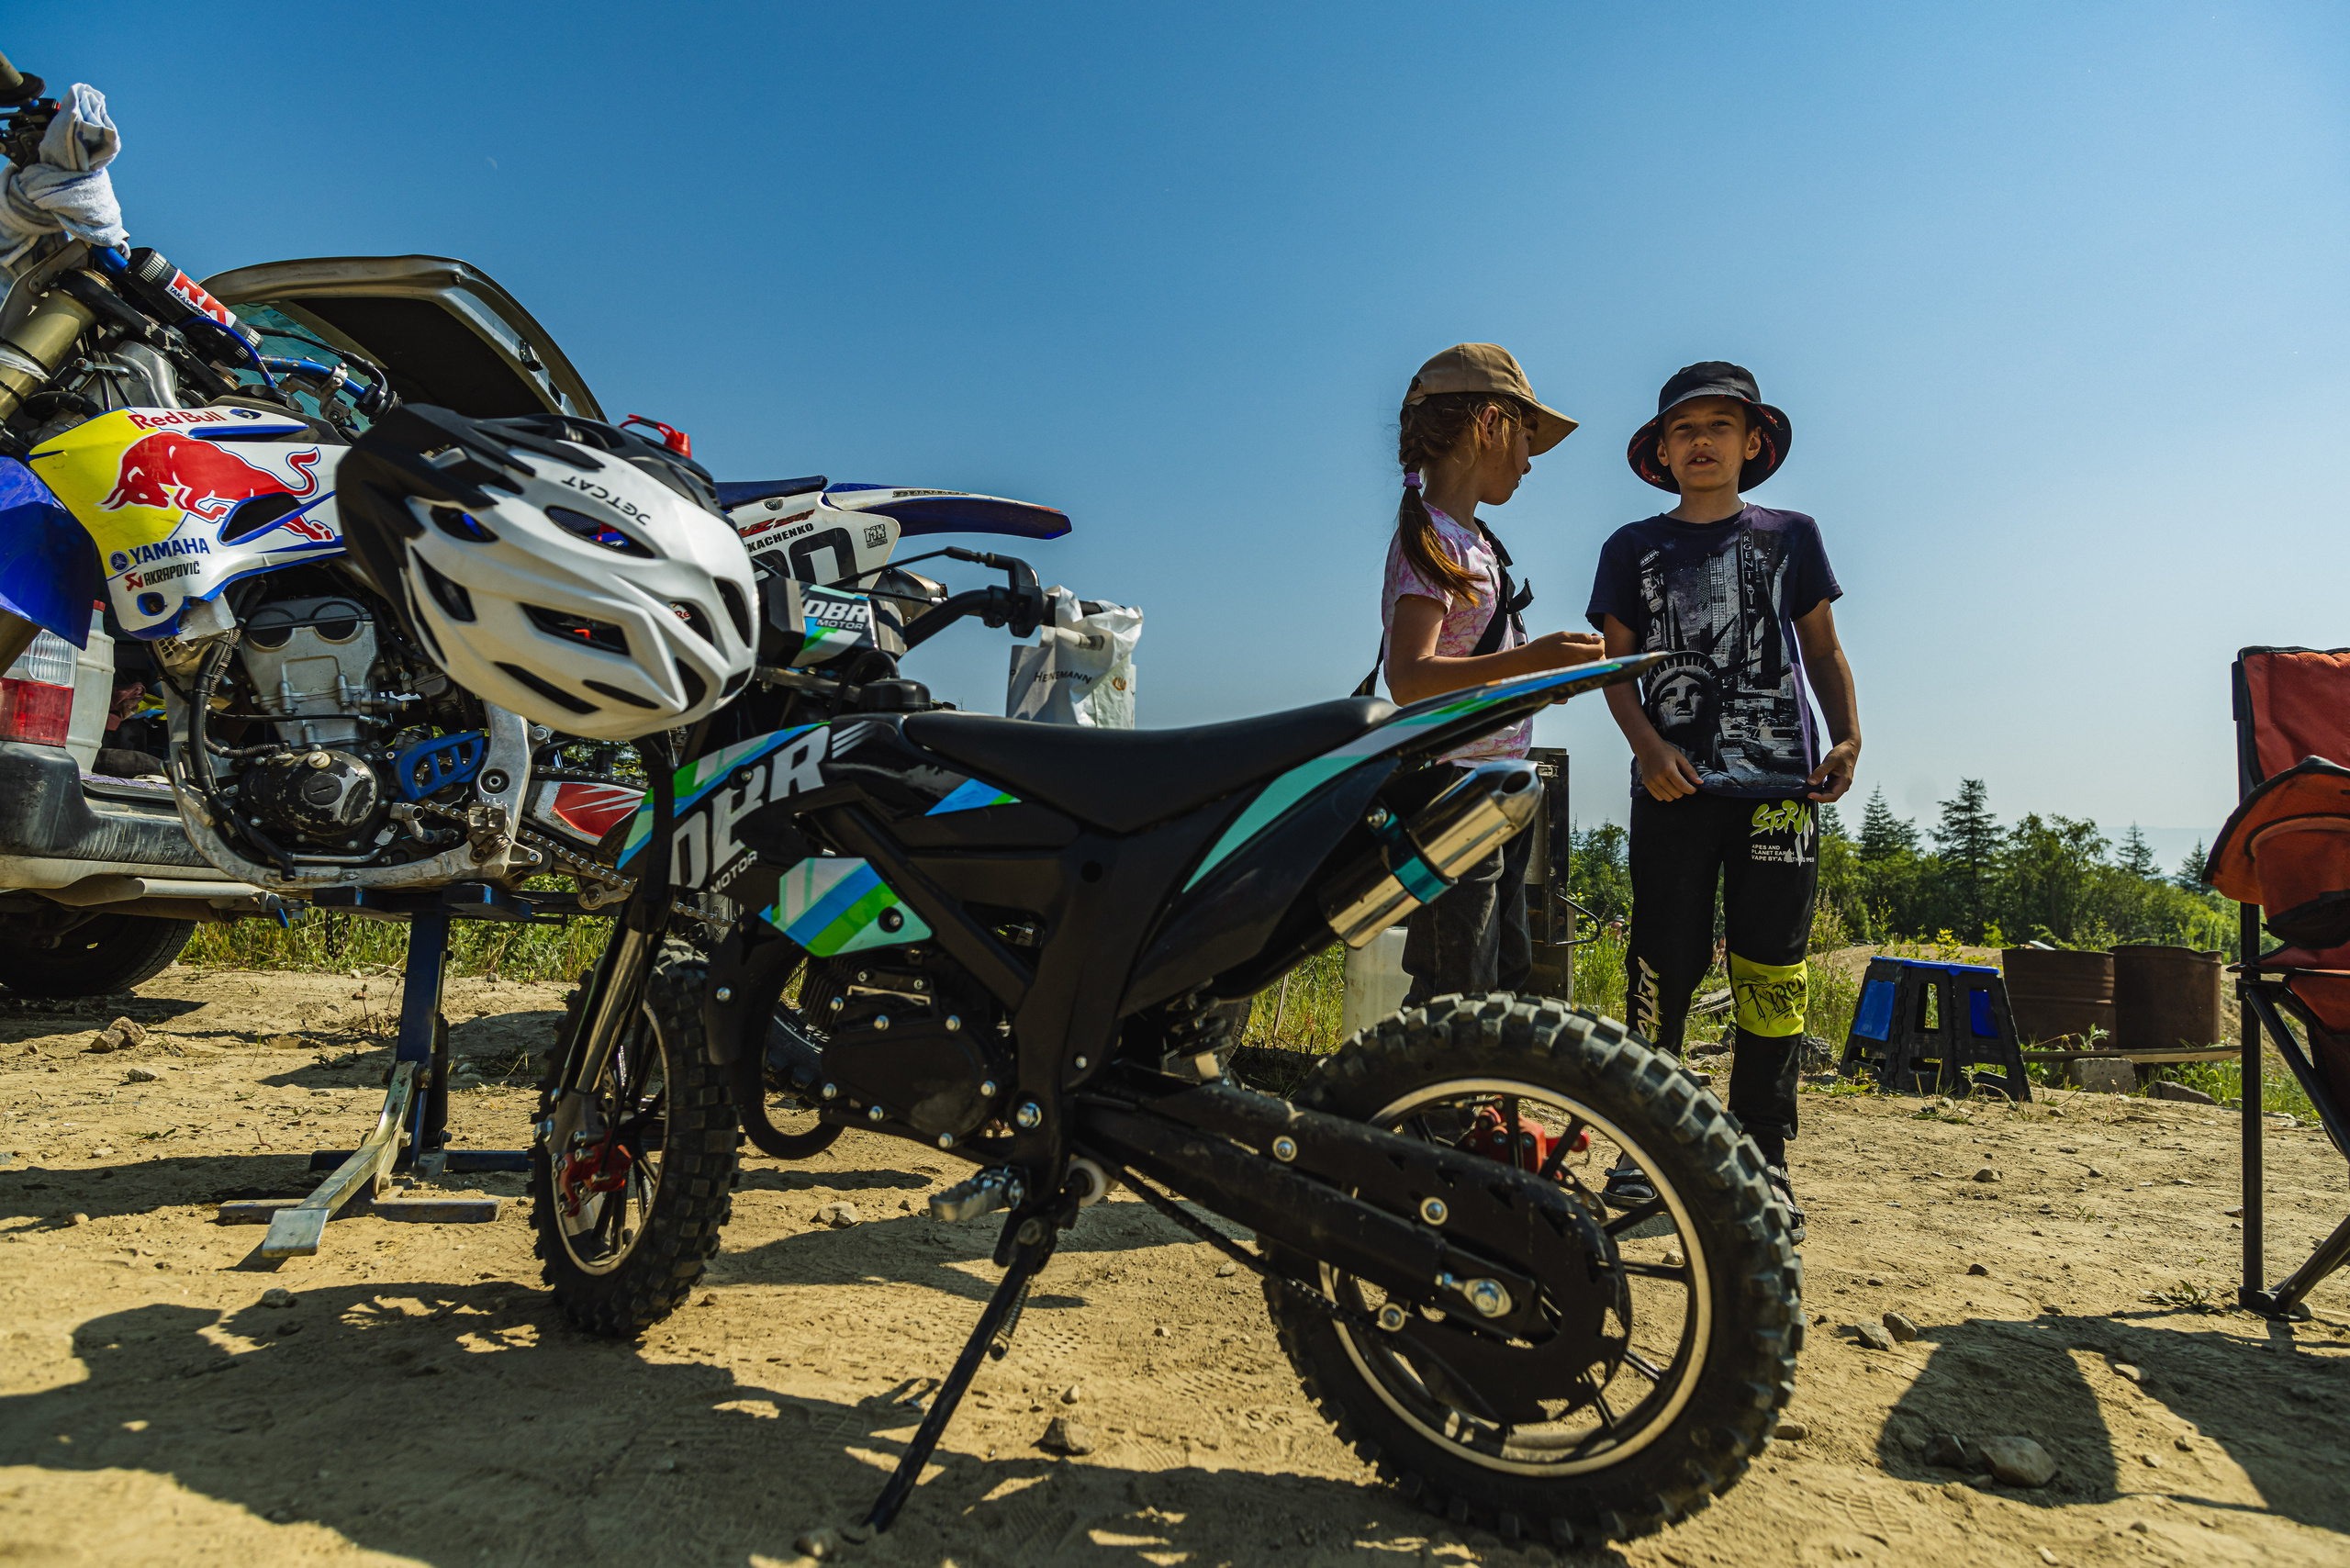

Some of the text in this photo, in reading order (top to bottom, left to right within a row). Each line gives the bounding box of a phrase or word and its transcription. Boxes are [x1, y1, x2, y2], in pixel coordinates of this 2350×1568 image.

[169, 286, 205, 316] TAKASAGO
[173, 271, 231, 326] RK
[128, 411, 229, 430] Red Bull
[561, 476, 652, 527] JETCAT
[128, 537, 211, 566] YAMAHA
[744, 522, 815, 554] KACHENKO
[143, 560, 201, 587] AKRAPOVIČ
[803, 599, 870, 623] DBR
[816, 619, 864, 631] MOTOR
[709, 850, 757, 893] MOTOR
